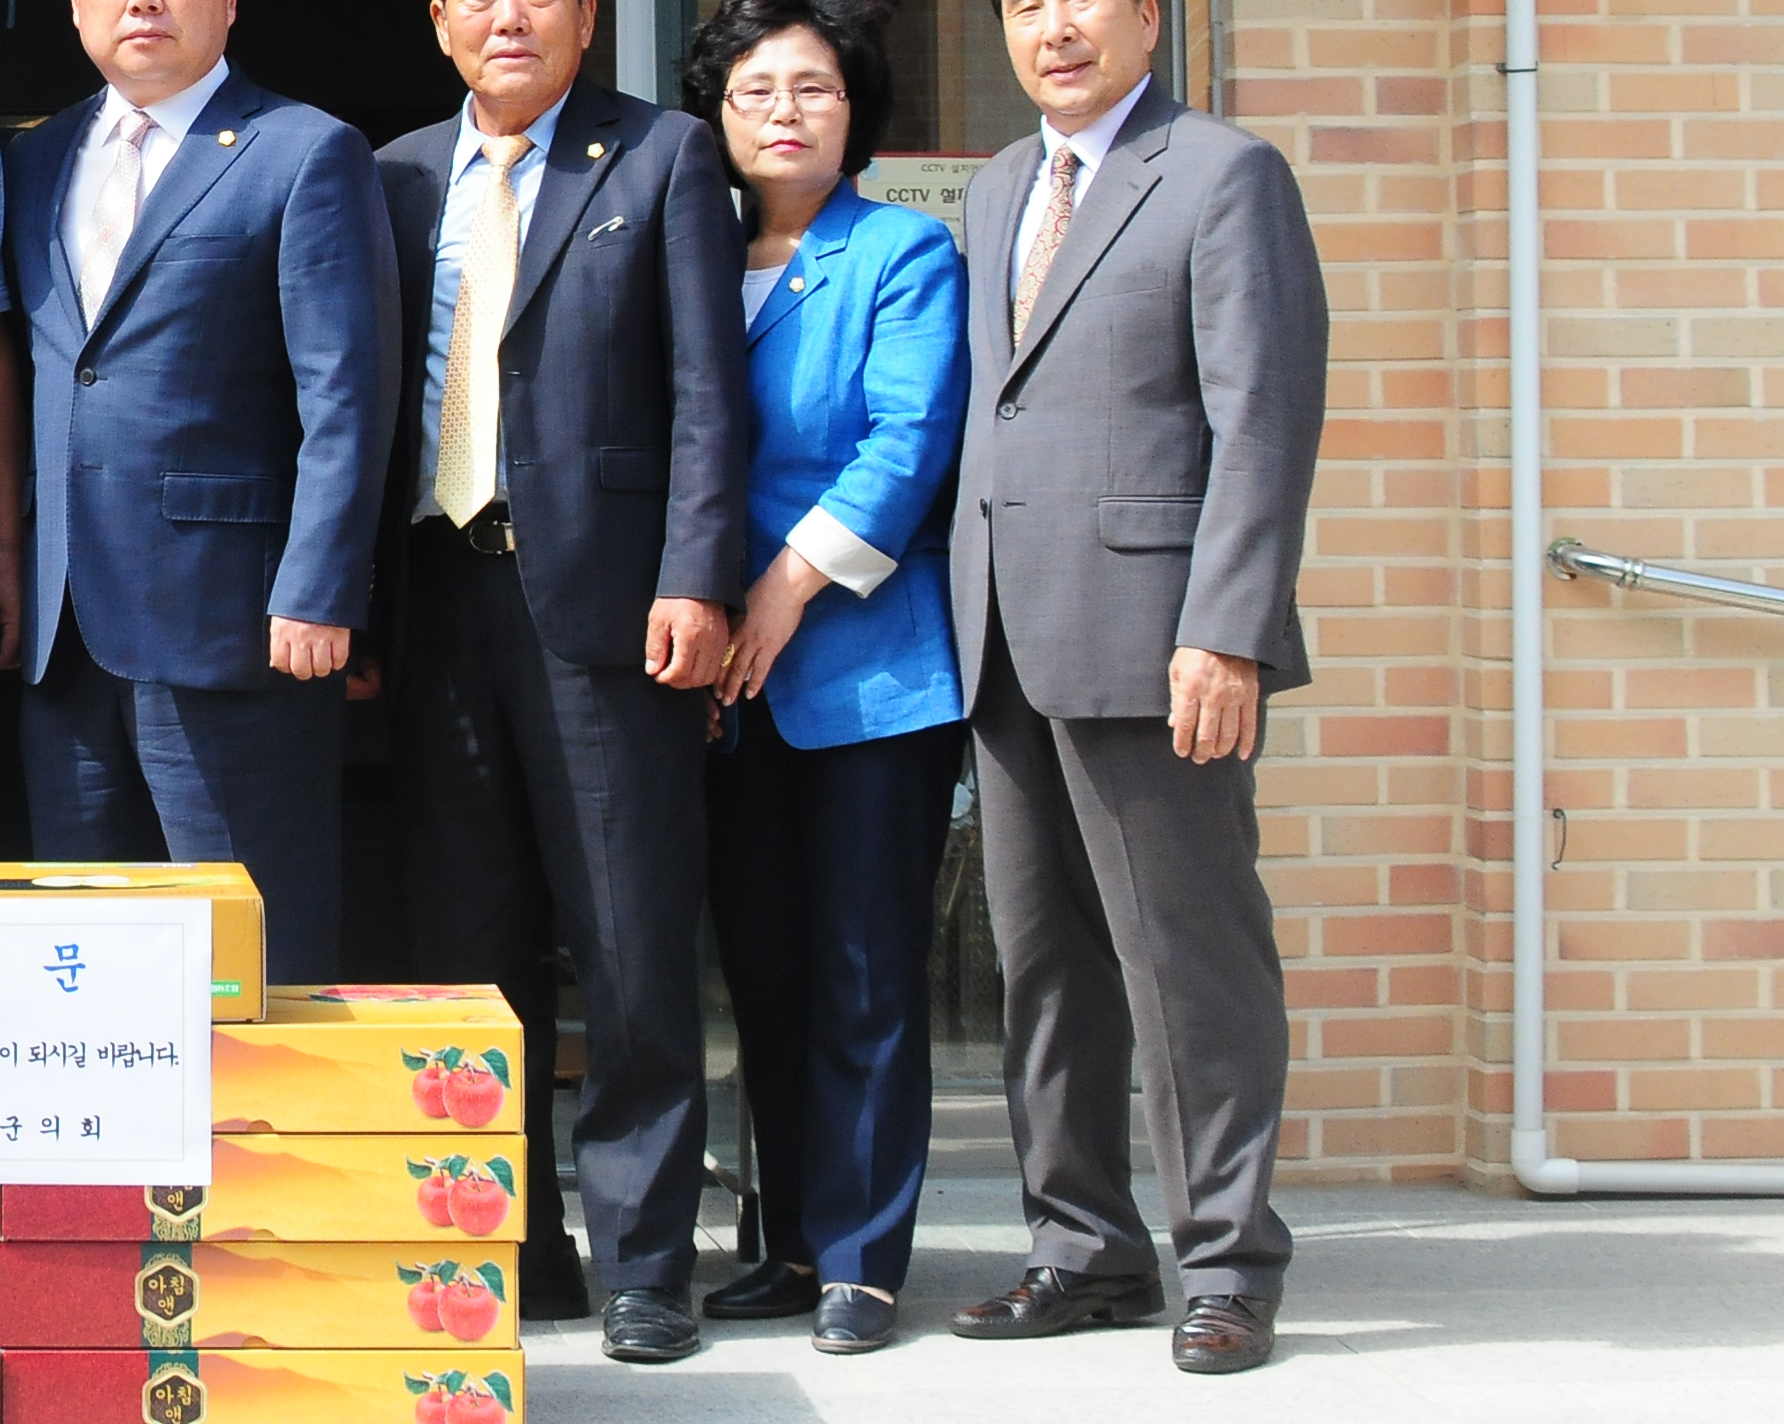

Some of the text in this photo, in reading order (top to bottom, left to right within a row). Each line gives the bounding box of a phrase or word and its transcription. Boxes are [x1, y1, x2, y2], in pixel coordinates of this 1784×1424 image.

[921, 163, 945, 172] CCTV
[885, 188, 930, 203] CCTV
[27, 1041, 87, 1069] 되시길
[97, 1041, 181, 1069] 바랍니다.
[148, 1274, 185, 1296] 아침
[155, 1384, 192, 1406] 아침
